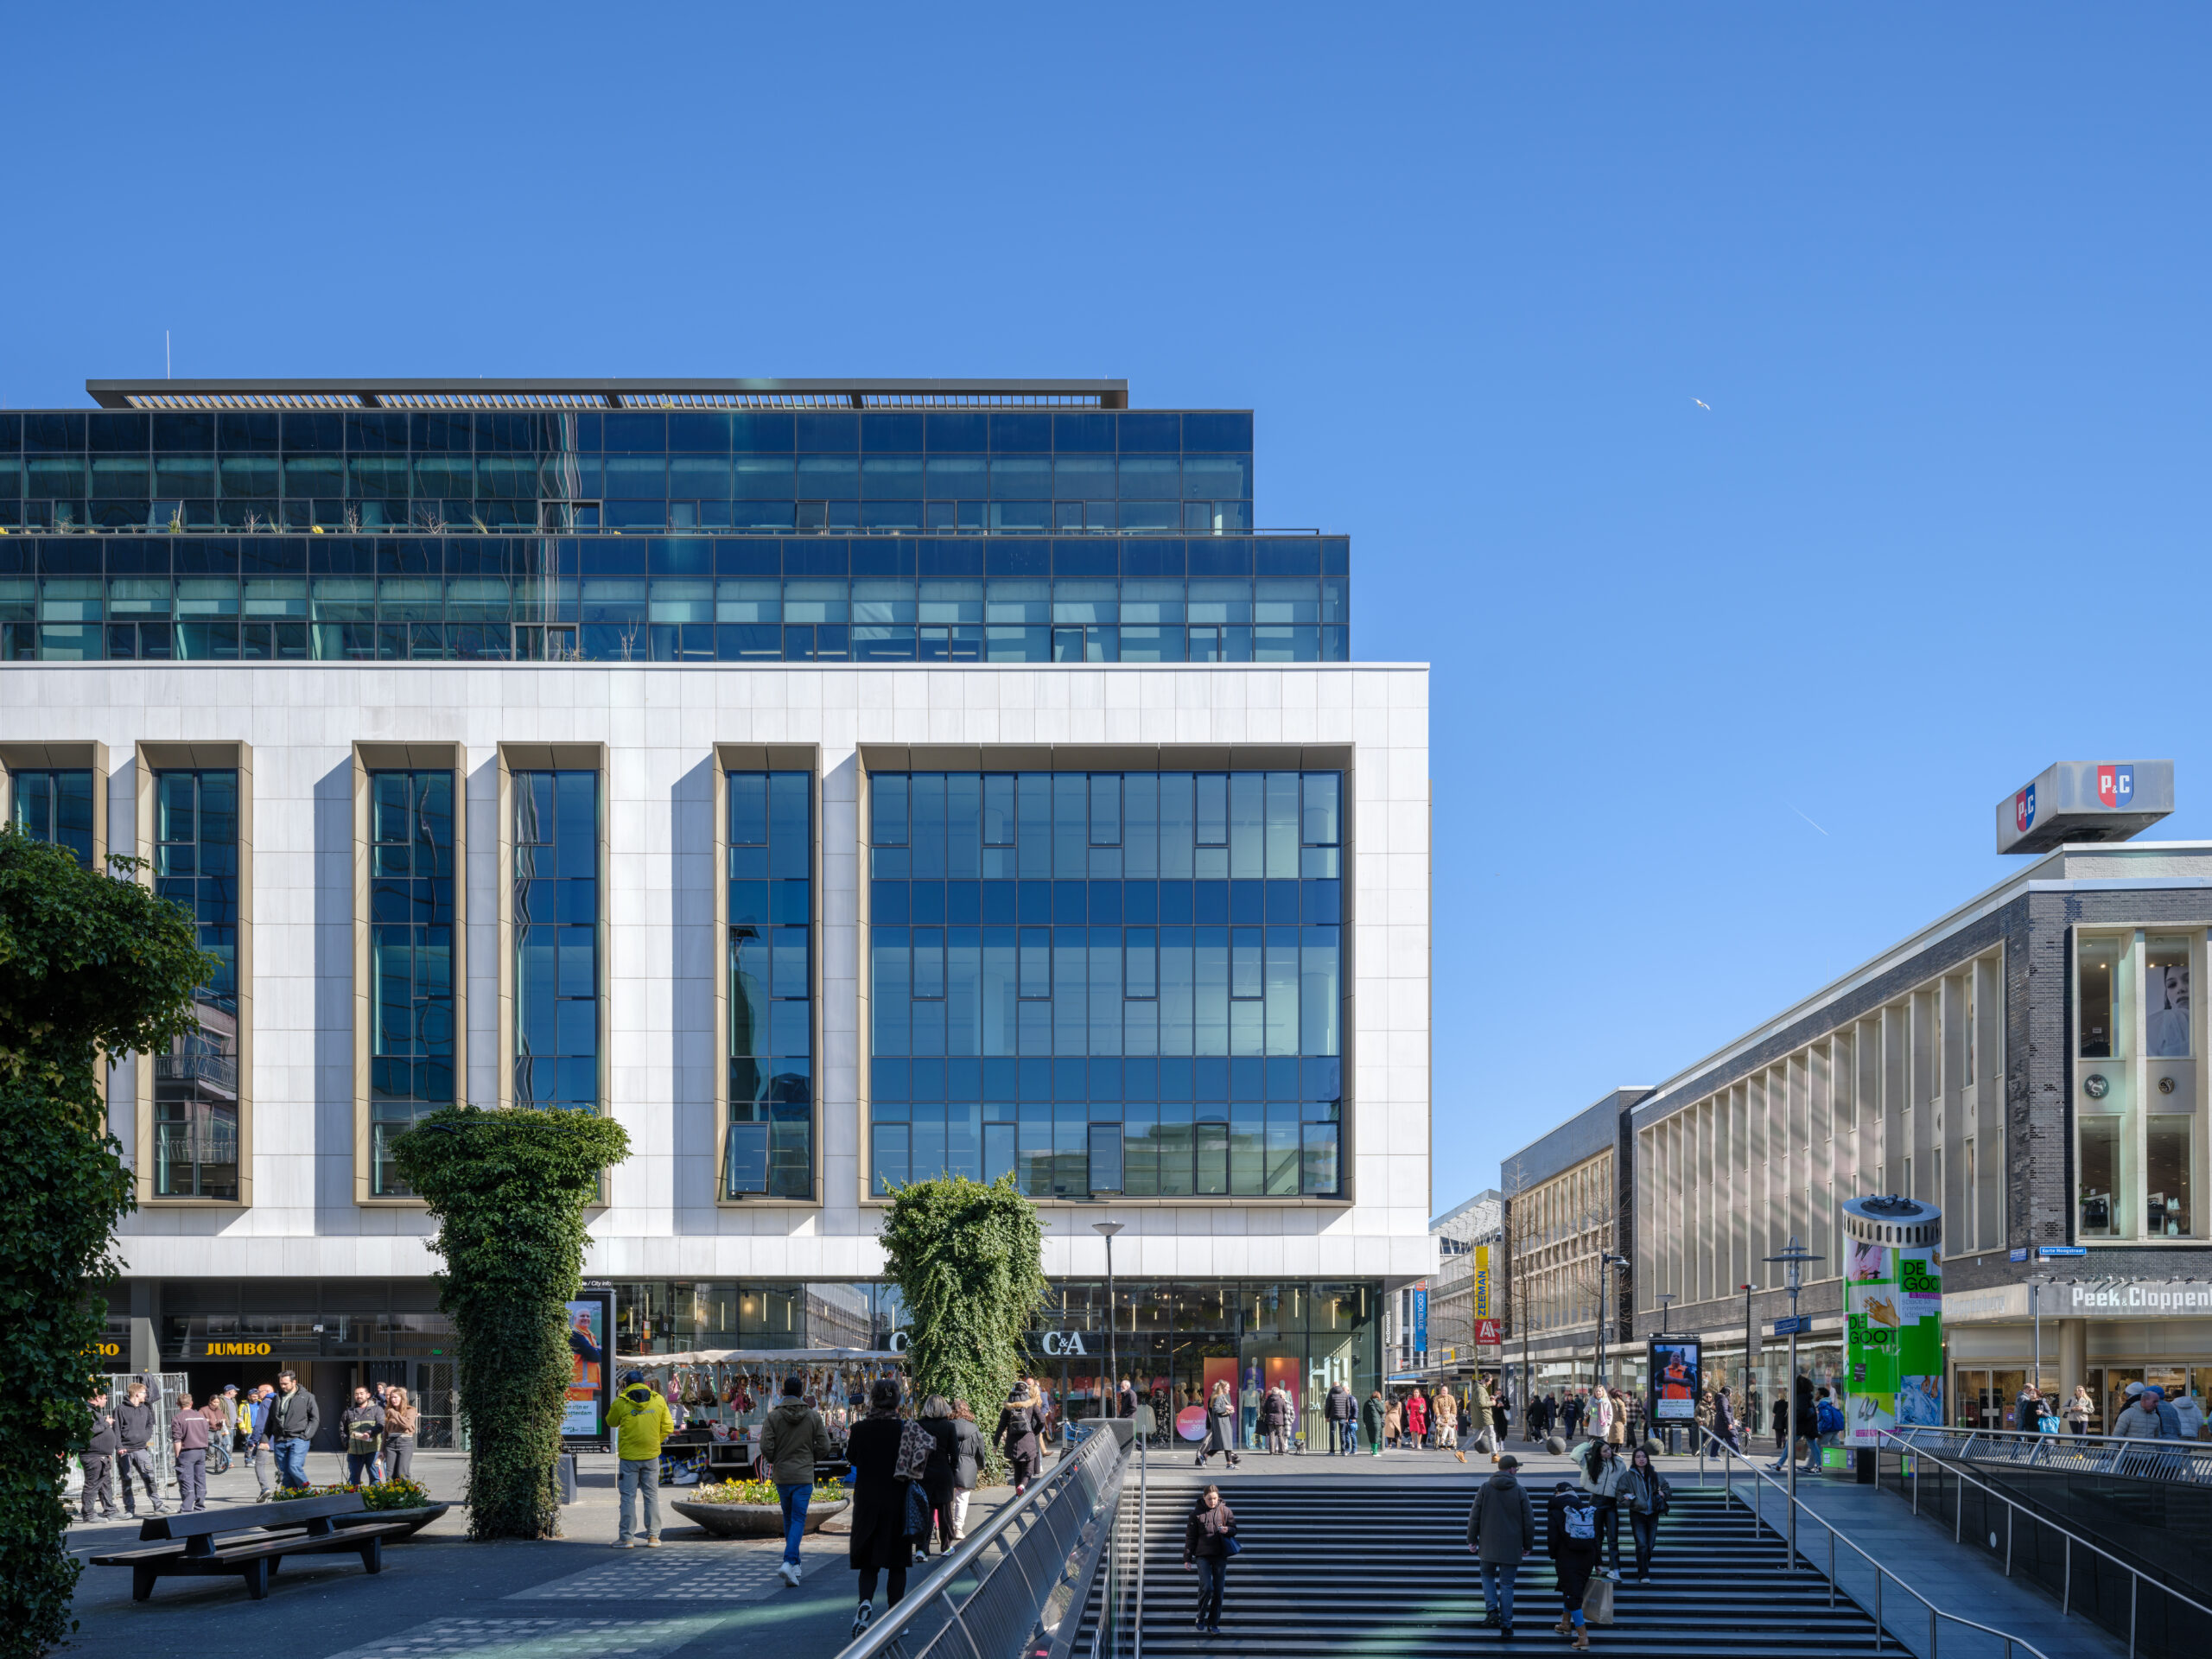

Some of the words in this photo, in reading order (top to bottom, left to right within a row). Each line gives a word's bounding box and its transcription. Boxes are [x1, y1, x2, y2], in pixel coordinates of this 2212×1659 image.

[2101, 775, 2130, 793] P&C
[2018, 795, 2034, 820] P&C
[1904, 1262, 1924, 1275] DE
[2072, 1287, 2120, 1306] Peek
[1849, 1316, 1866, 1330] DE
[1042, 1331, 1088, 1356] C&A
[1850, 1330, 1898, 1344] GOOT
[205, 1343, 271, 1356] JUMBO
